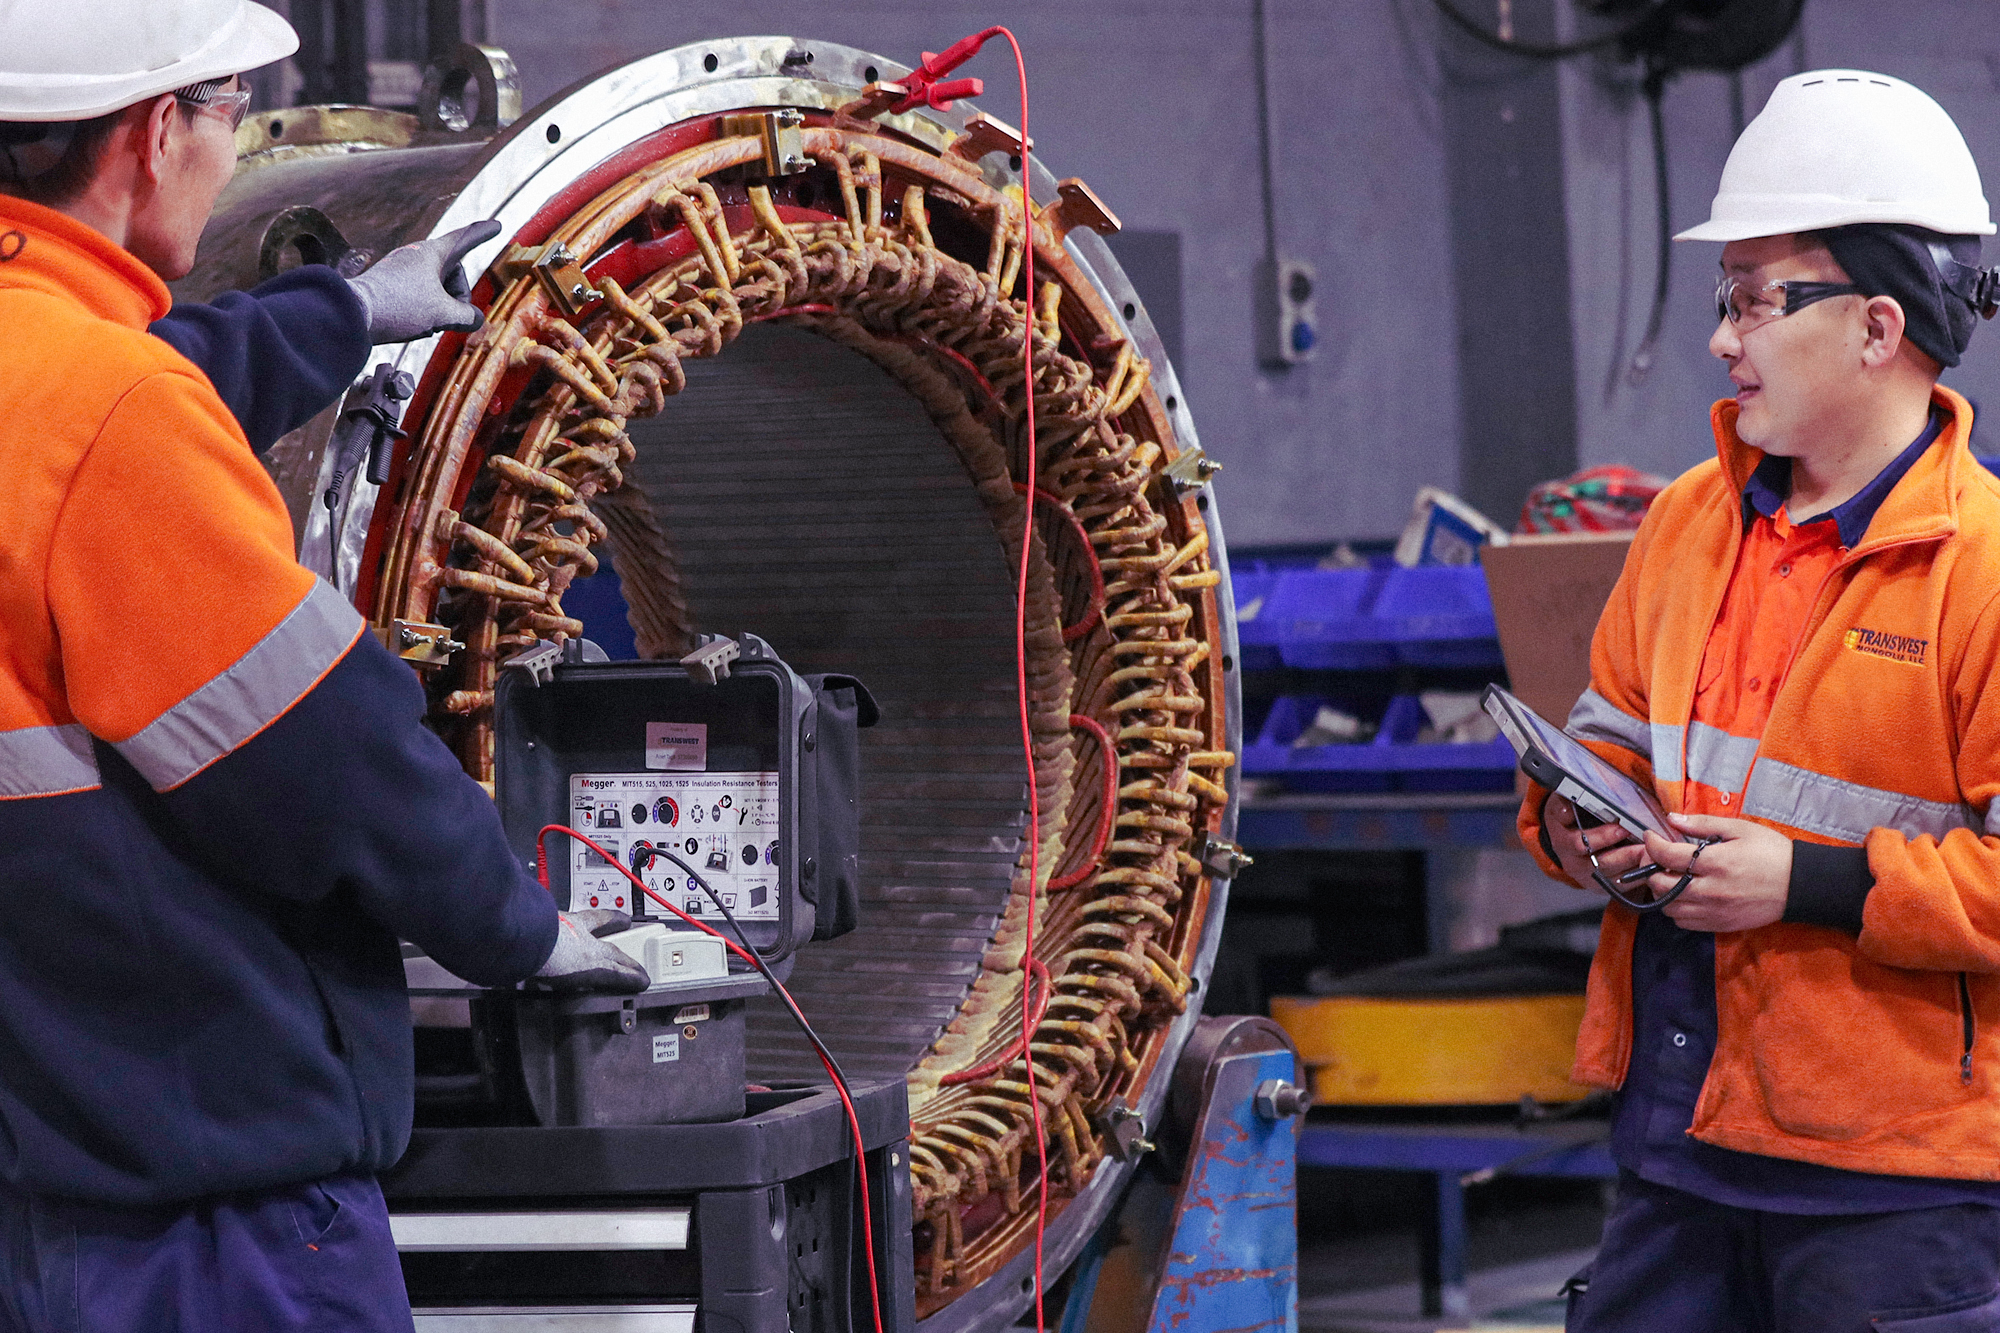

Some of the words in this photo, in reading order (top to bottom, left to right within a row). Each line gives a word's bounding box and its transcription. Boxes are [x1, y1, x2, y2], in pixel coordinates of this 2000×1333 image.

[1857, 628, 1929, 656] TRANSWEST
[1909, 656, 1925, 664] LLC
[661, 737, 699, 745] TRANSWEST
[622, 780, 644, 788] MIT515,
[645, 780, 658, 788] 525,
[659, 780, 674, 788] 1025,
[722, 779, 755, 787] Resistance
[756, 779, 778, 787] Testers
